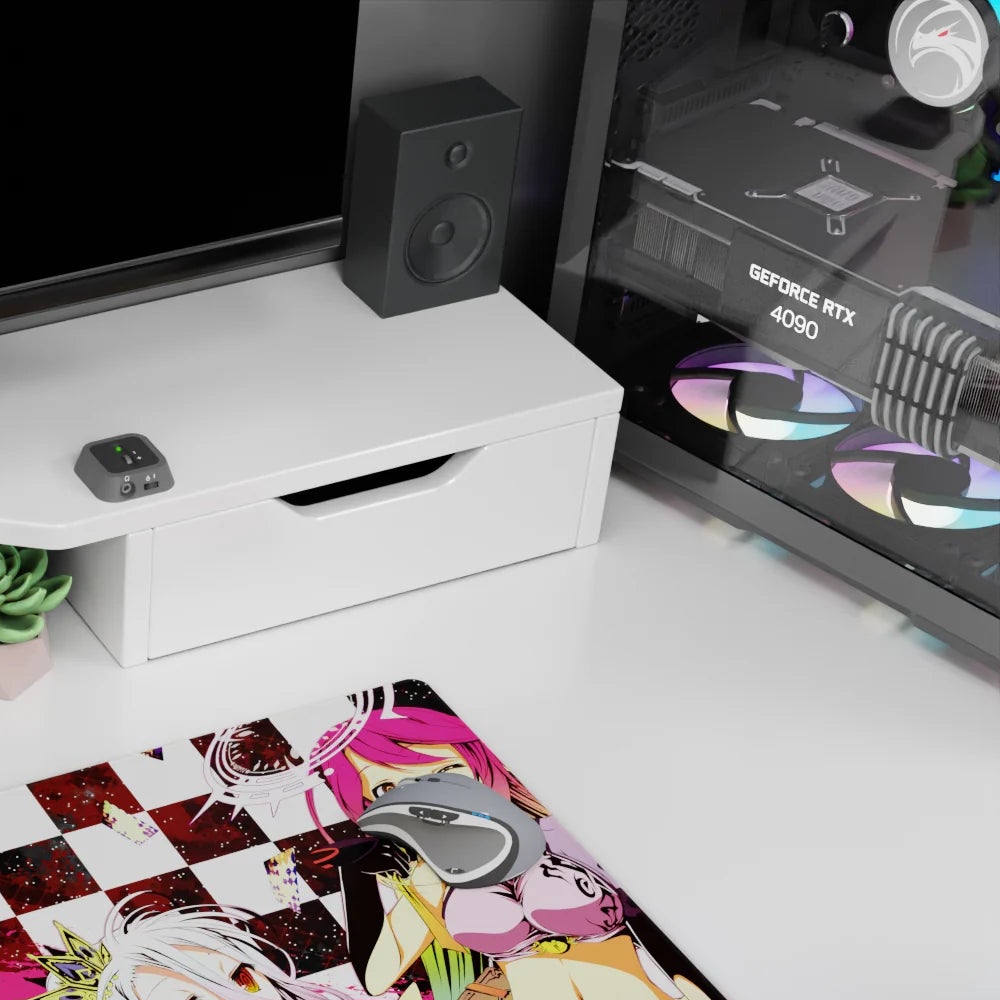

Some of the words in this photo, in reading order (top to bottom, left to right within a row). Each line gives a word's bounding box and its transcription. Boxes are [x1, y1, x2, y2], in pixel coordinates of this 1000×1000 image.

[749, 263, 821, 310] GEFORCE
[822, 297, 857, 327] RTX
[769, 305, 819, 340] 4090
